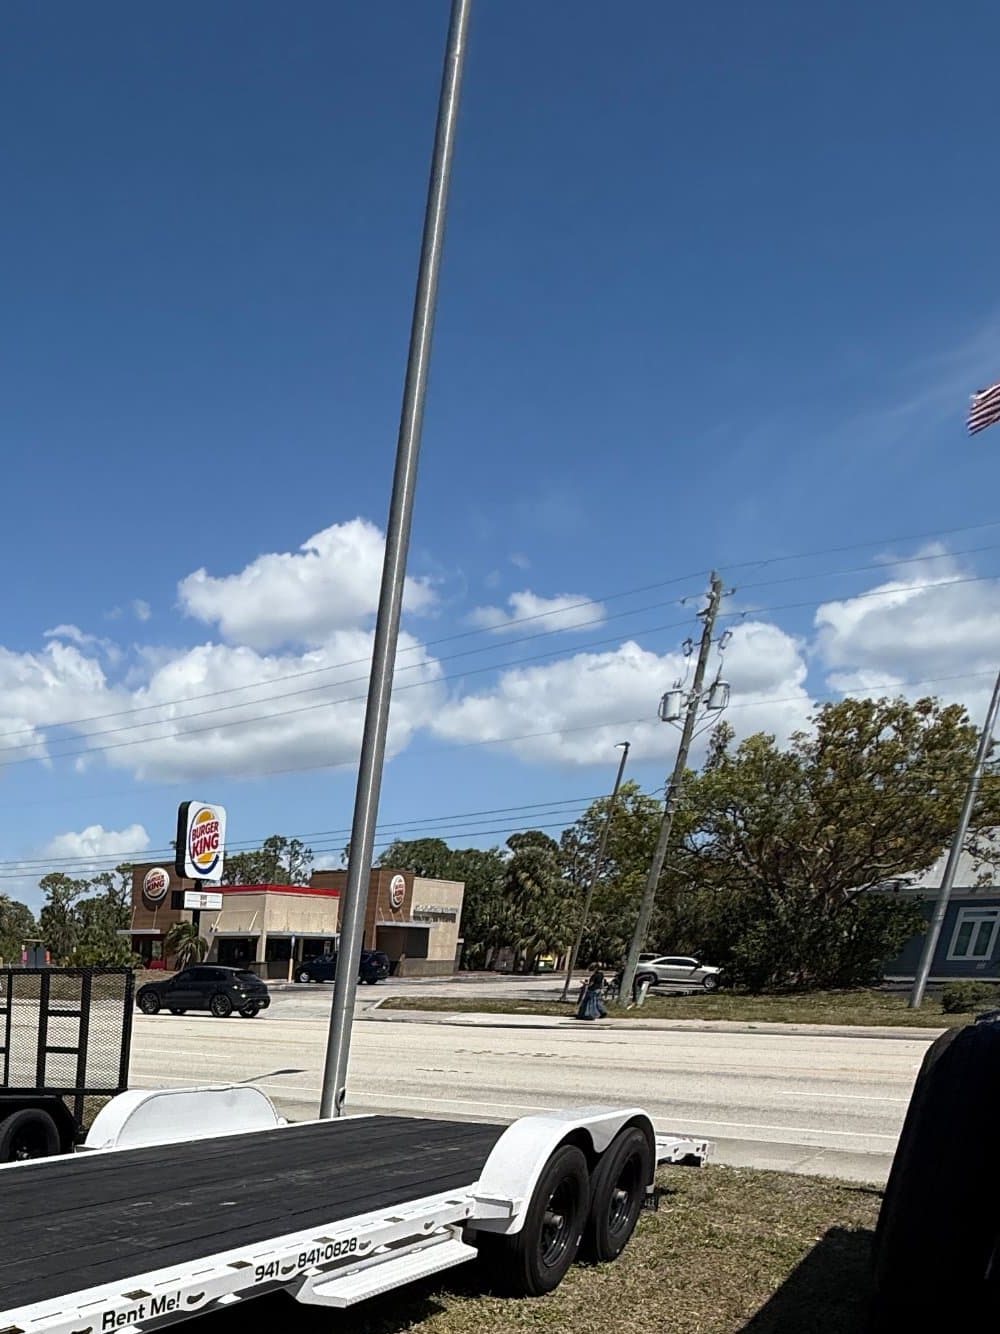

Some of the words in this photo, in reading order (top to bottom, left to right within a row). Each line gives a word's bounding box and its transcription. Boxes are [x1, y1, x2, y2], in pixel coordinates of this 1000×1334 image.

[192, 822, 219, 841] BURGER
[193, 834, 219, 859] KING
[147, 880, 165, 891] KING
[254, 1260, 280, 1282] 941
[101, 1304, 145, 1331] Rent
[150, 1290, 181, 1316] Me!
